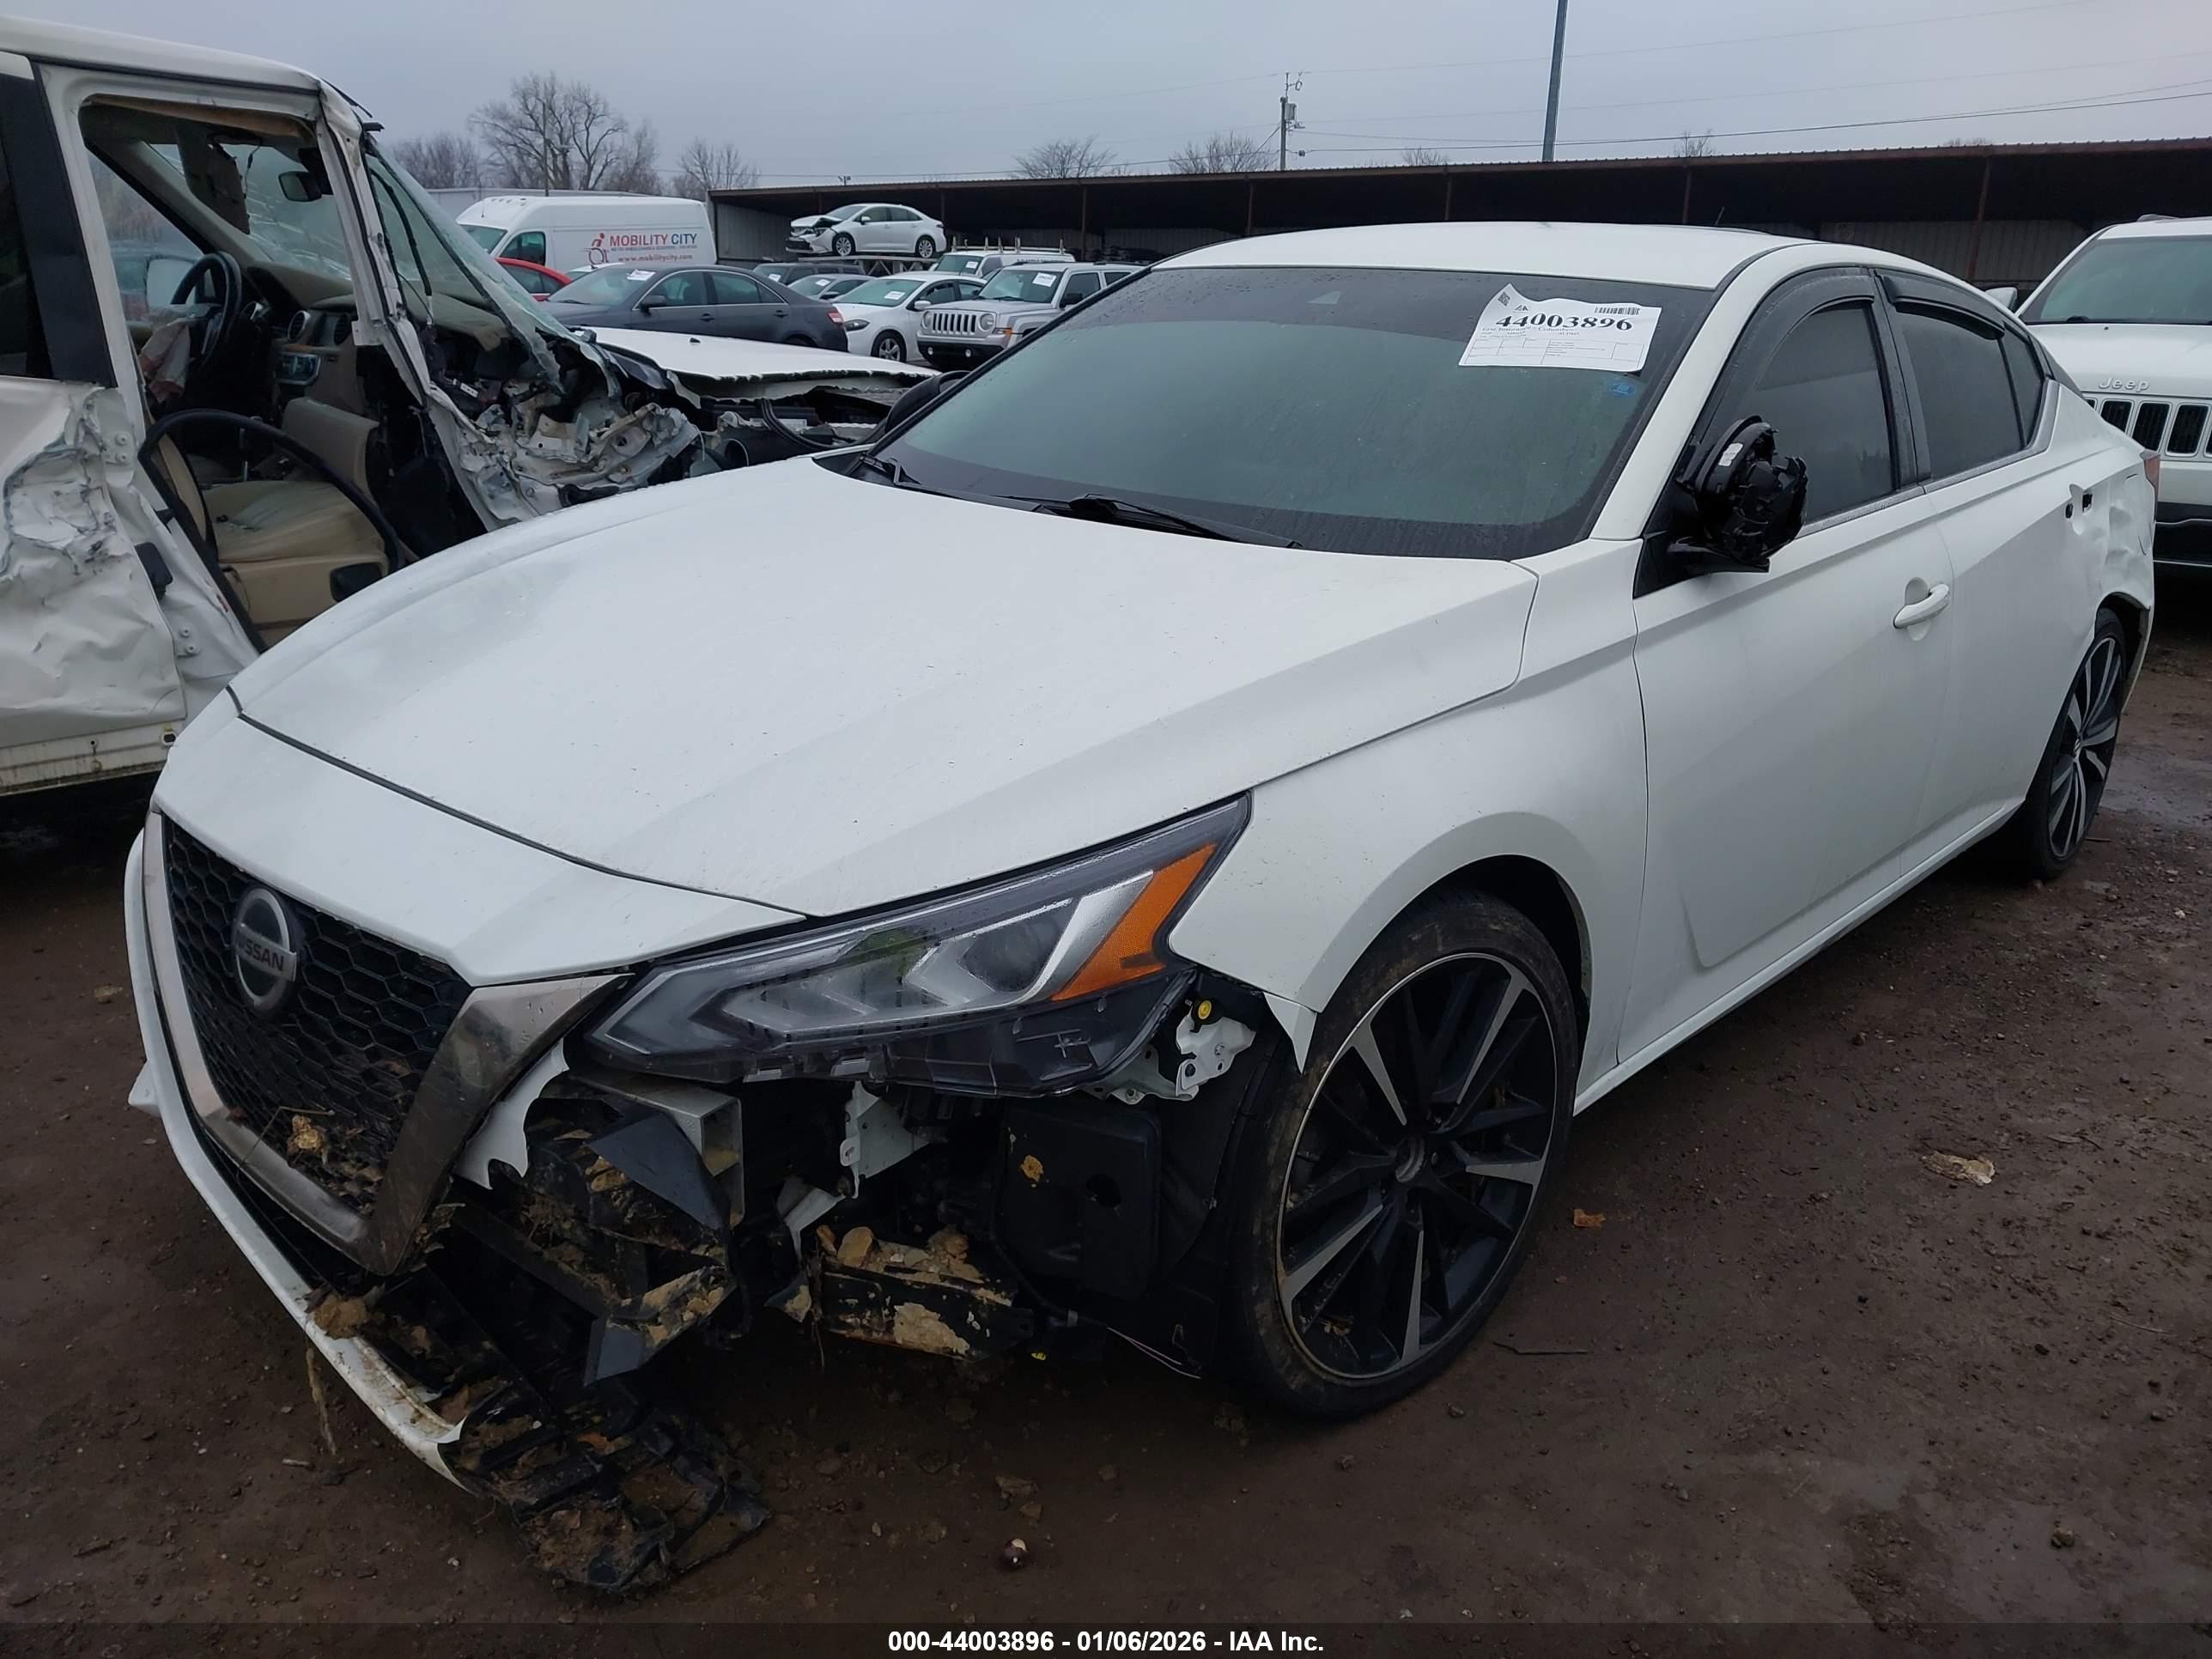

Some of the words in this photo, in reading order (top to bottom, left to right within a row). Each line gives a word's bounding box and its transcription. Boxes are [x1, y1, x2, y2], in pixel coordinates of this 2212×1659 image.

[610, 234, 668, 246] MOBILITY
[671, 233, 697, 246] CITY
[1496, 313, 1632, 331] 44003896
[2099, 377, 2149, 392] Jeep
